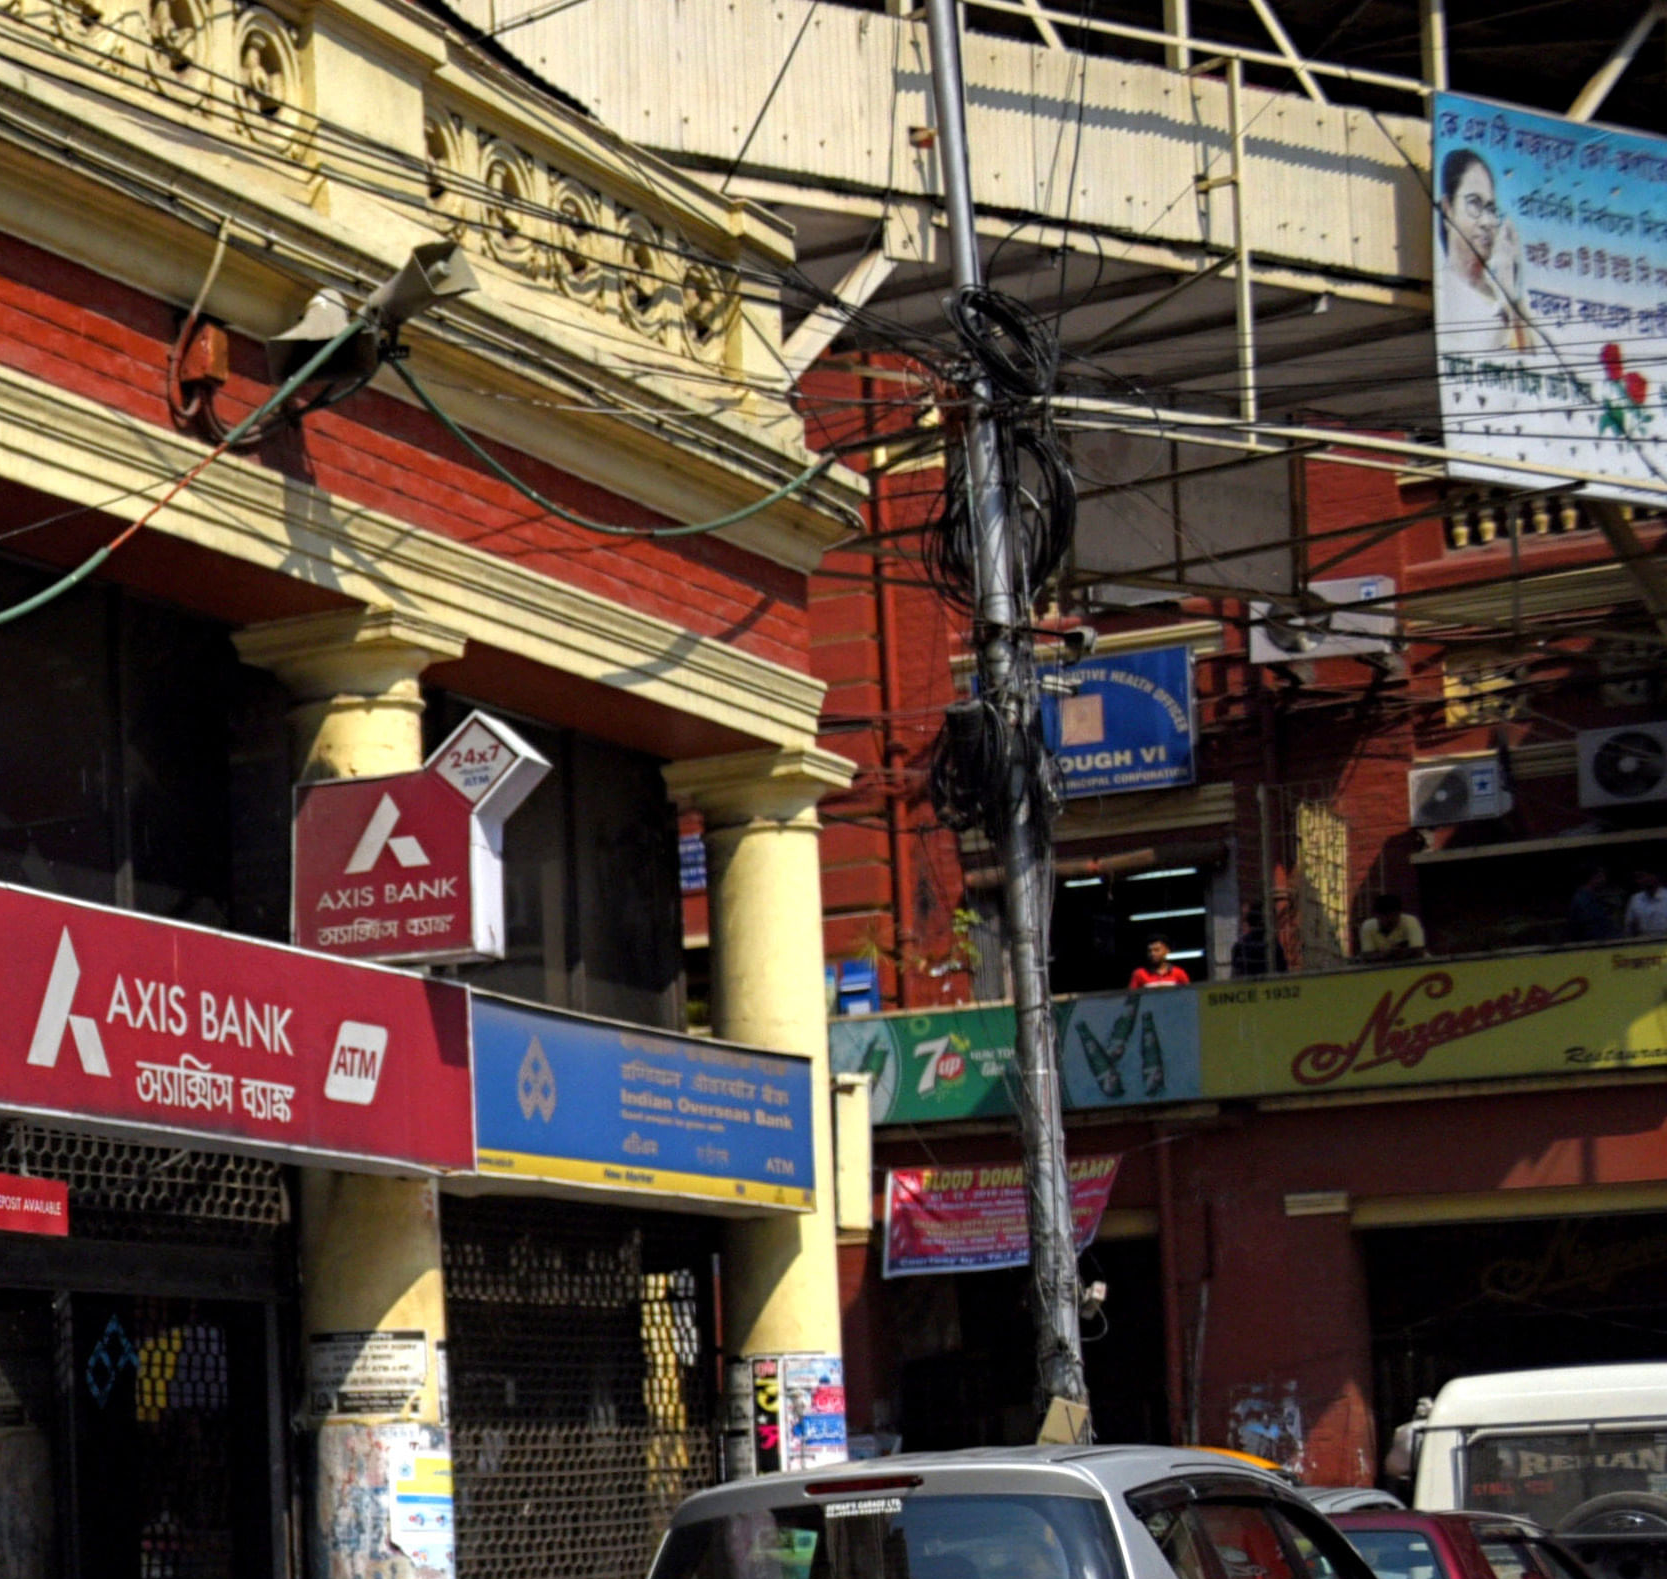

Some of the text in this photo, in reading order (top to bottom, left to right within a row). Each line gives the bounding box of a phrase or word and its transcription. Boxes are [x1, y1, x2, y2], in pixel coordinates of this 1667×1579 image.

[1060, 745, 1167, 774] OUGH VI
[464, 776, 490, 787] ATM
[317, 877, 457, 912] AXIS BANK
[1208, 985, 1301, 1006] SINCE 1932
[106, 973, 295, 1056] AXIS BANK
[1291, 973, 1590, 1086] Nizam's
[334, 1045, 377, 1081] ATM
[240, 1077, 295, 1123] ব্যাঙ্ক
[620, 1088, 793, 1130] Indian Overseas Bank
[766, 1157, 795, 1176] ATM
[923, 1159, 1116, 1192] BLOOD DONA CAMP
[23, 1197, 62, 1216] AVAILABLE
